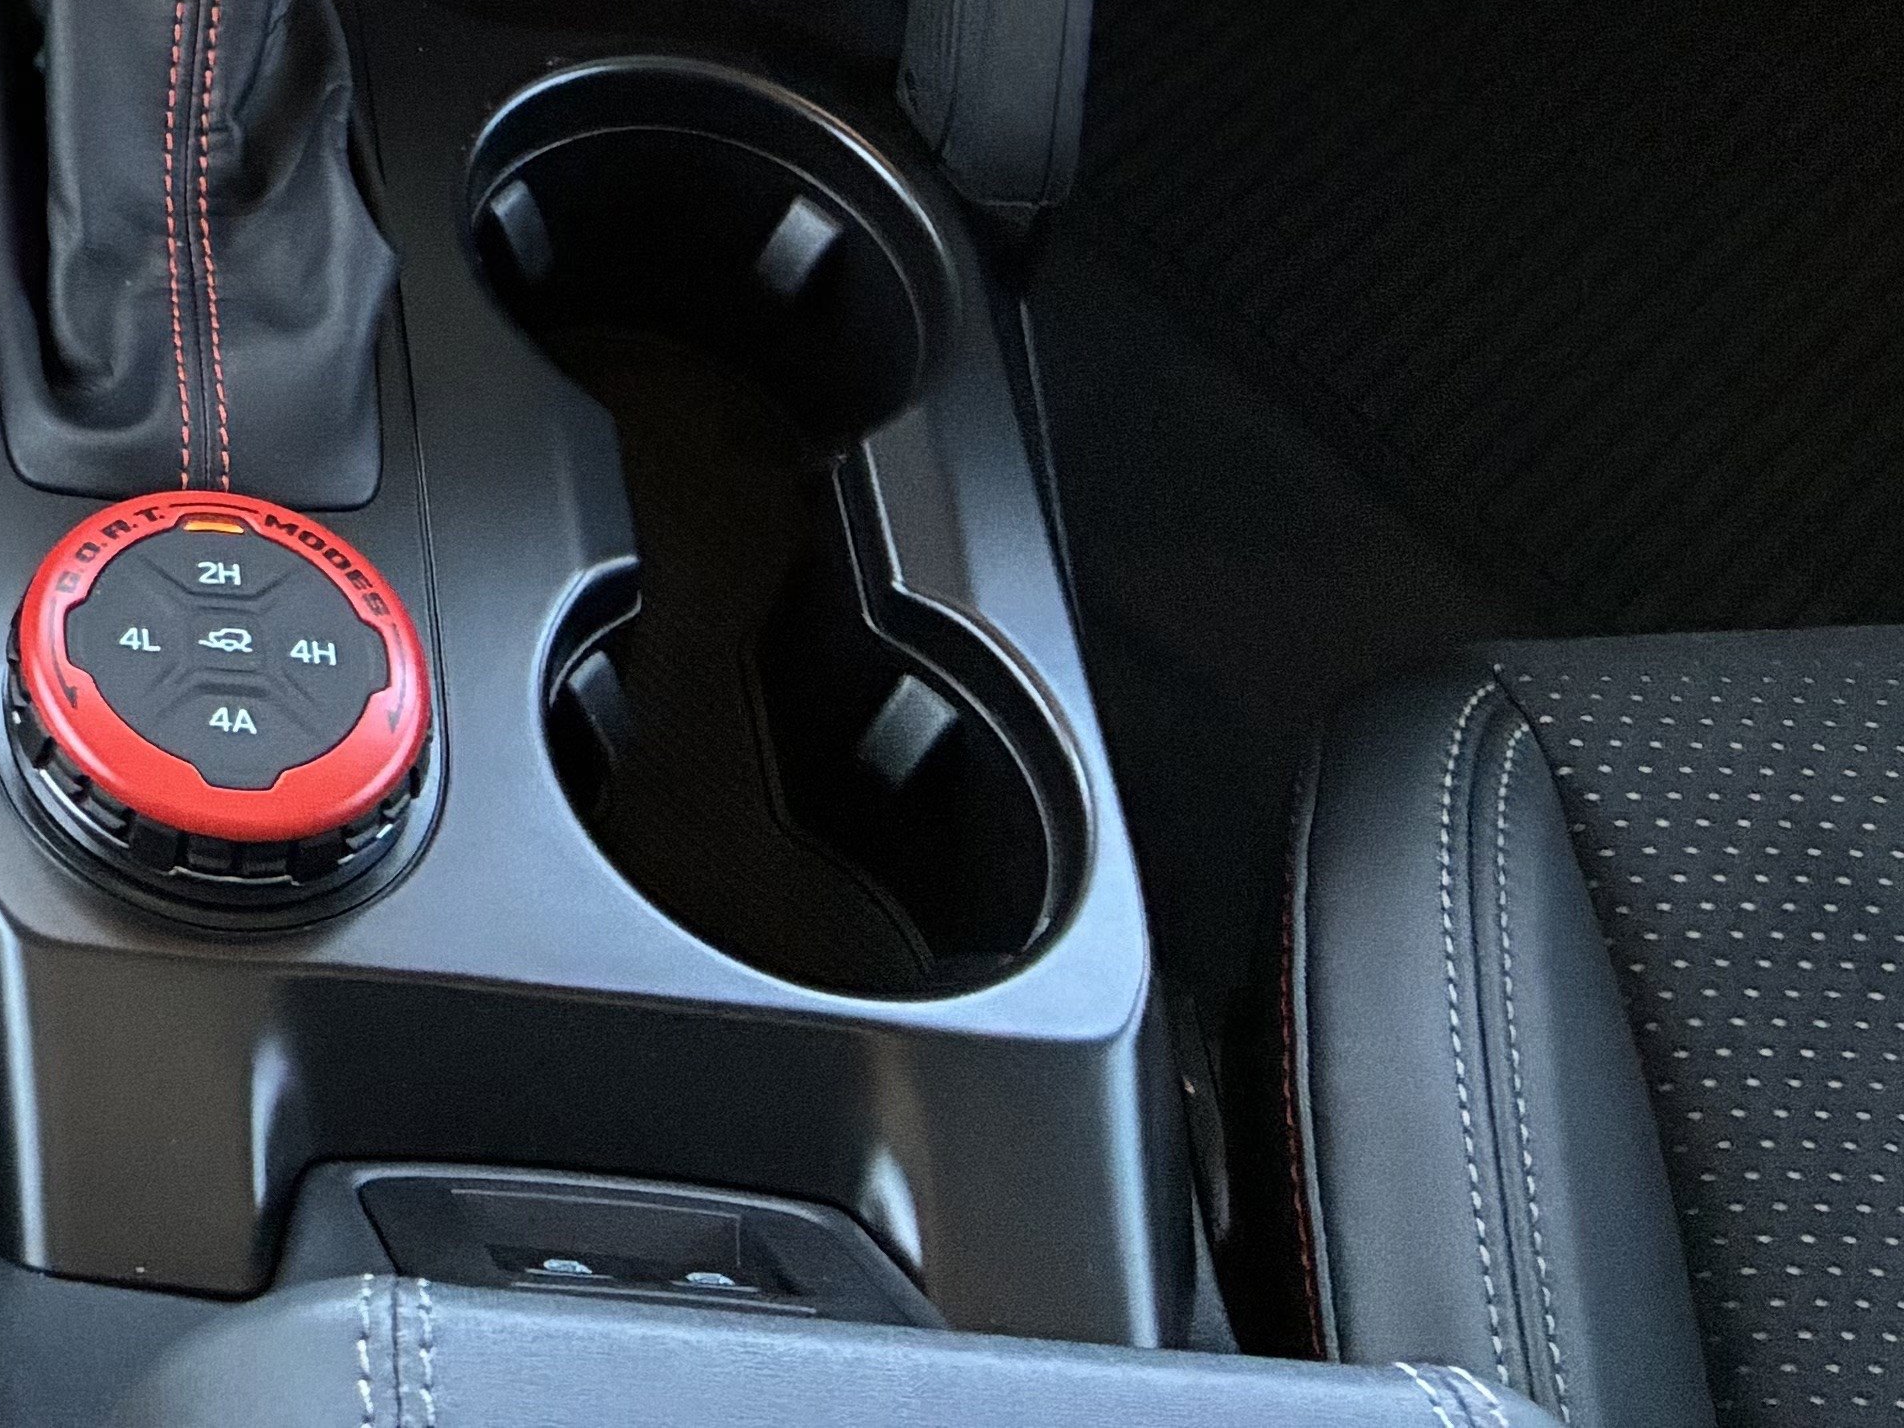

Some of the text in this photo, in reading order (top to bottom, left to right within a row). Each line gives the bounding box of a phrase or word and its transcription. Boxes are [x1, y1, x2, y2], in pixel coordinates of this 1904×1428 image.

[198, 561, 242, 587] 2H
[265, 513, 392, 617] MODES
[119, 627, 161, 653] 4L
[290, 640, 337, 666] 4H
[209, 707, 257, 735] 4A
